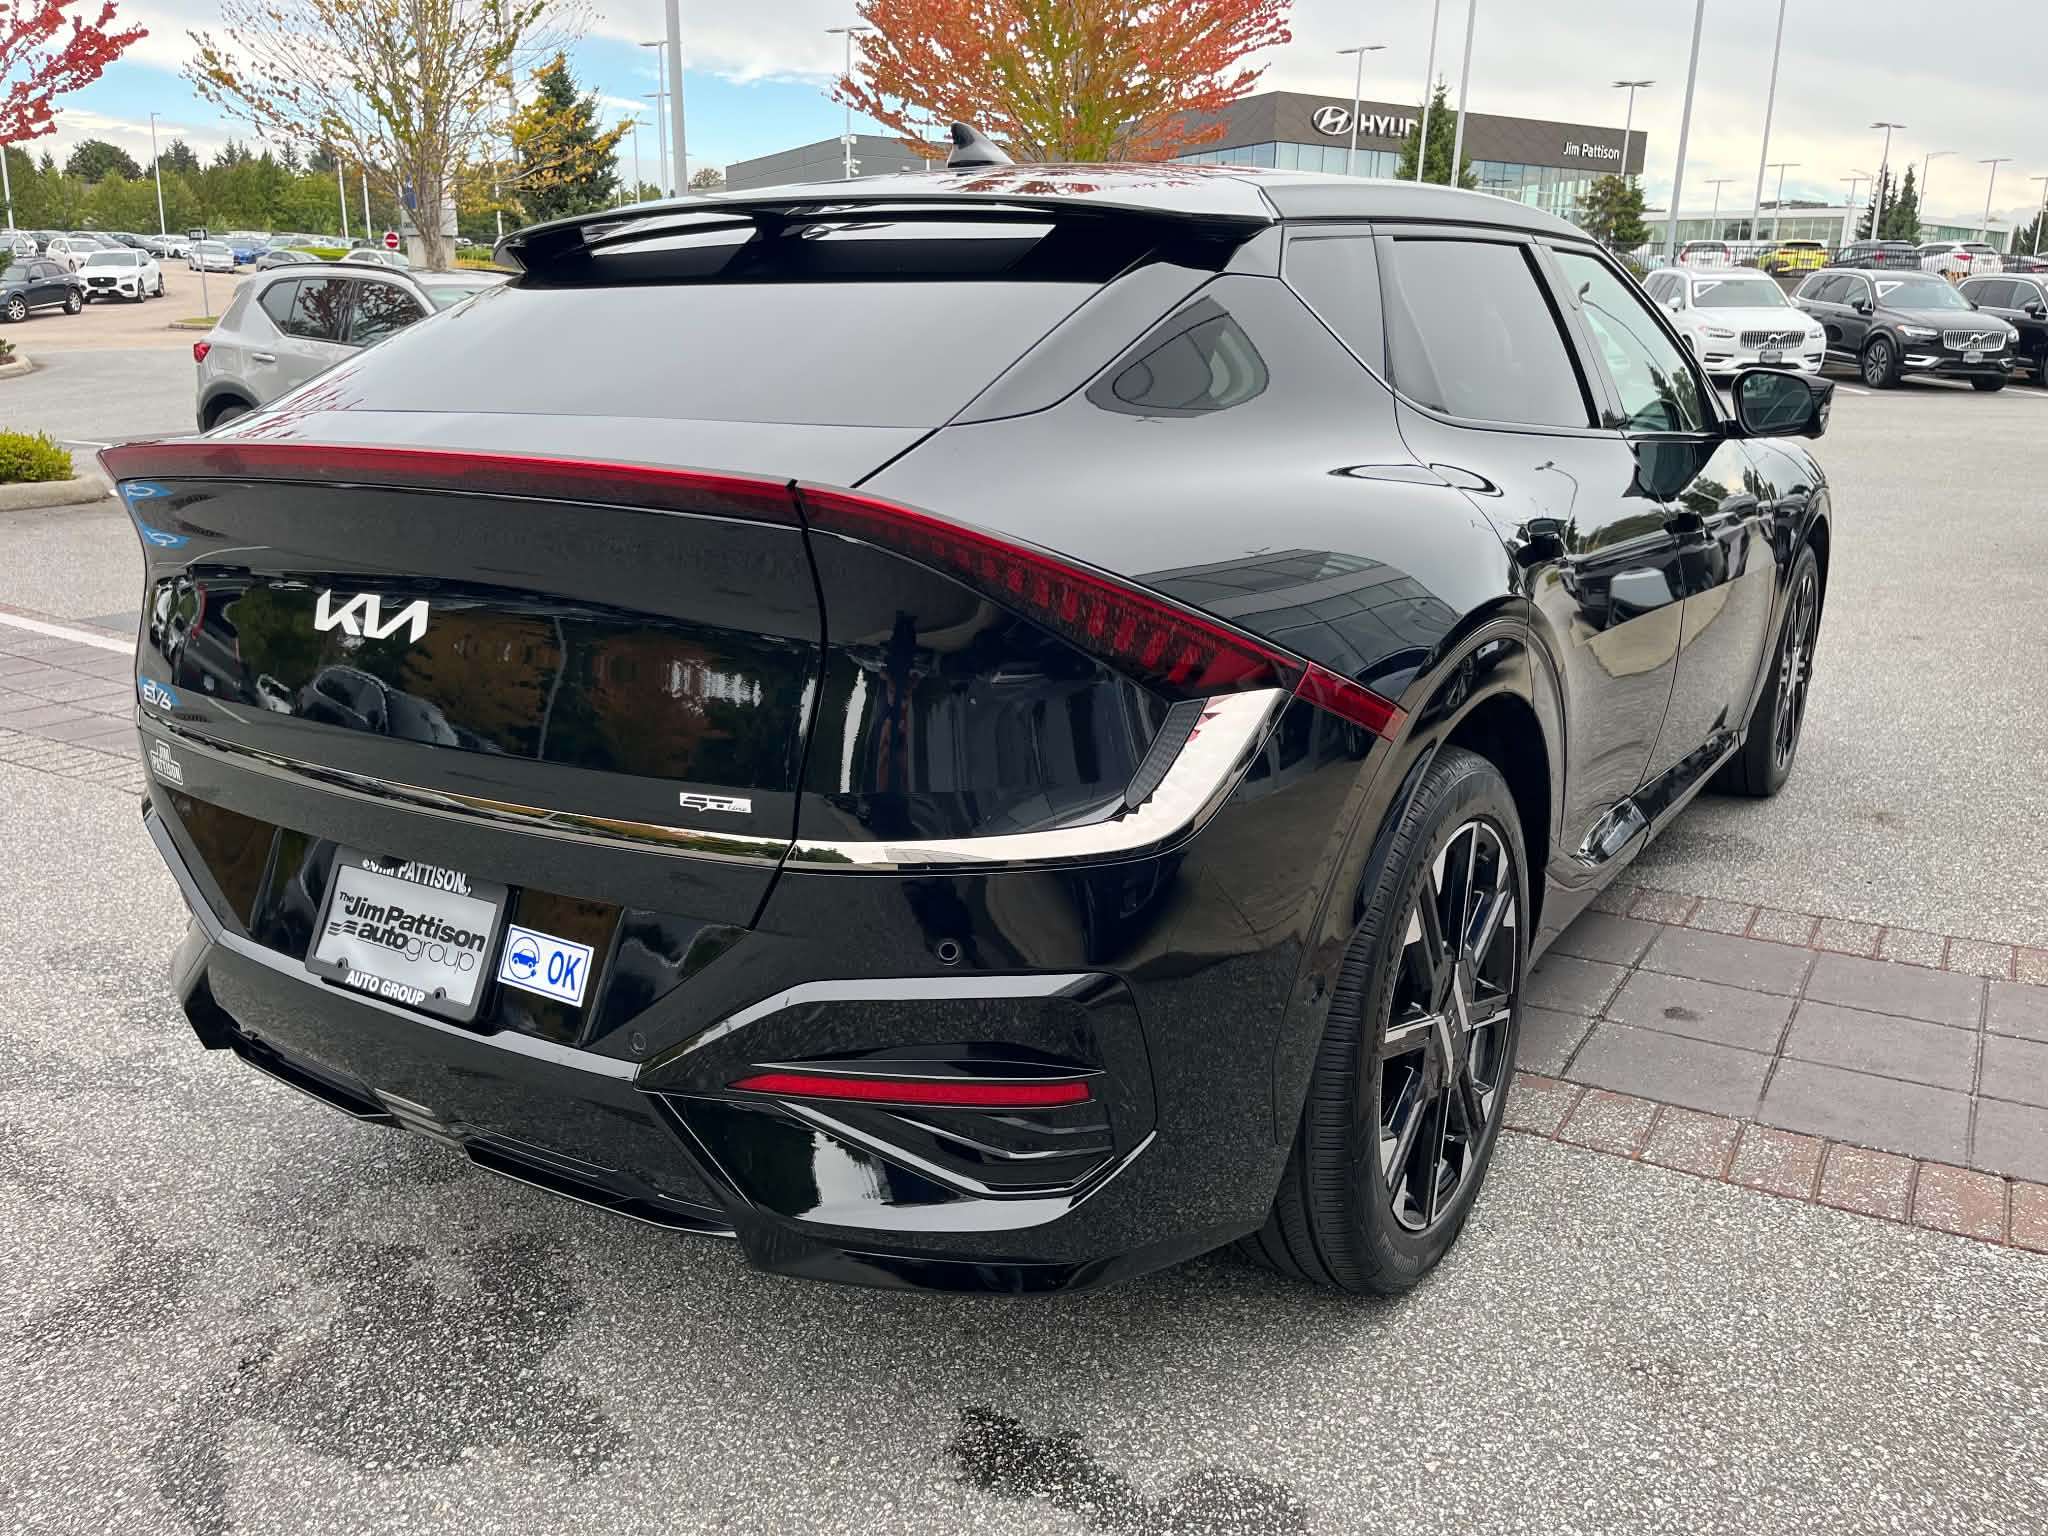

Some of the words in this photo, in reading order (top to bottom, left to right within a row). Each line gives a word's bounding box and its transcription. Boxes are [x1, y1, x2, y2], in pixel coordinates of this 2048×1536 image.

[1564, 142, 1579, 157] Jim
[1582, 144, 1620, 160] Pattison
[314, 588, 429, 644] KIA
[339, 892, 355, 903] The
[345, 896, 385, 924] Jim
[383, 905, 486, 952] Pattison
[344, 970, 380, 992] AUTO
[380, 981, 426, 1006] GROUP
[547, 951, 582, 992] OK
